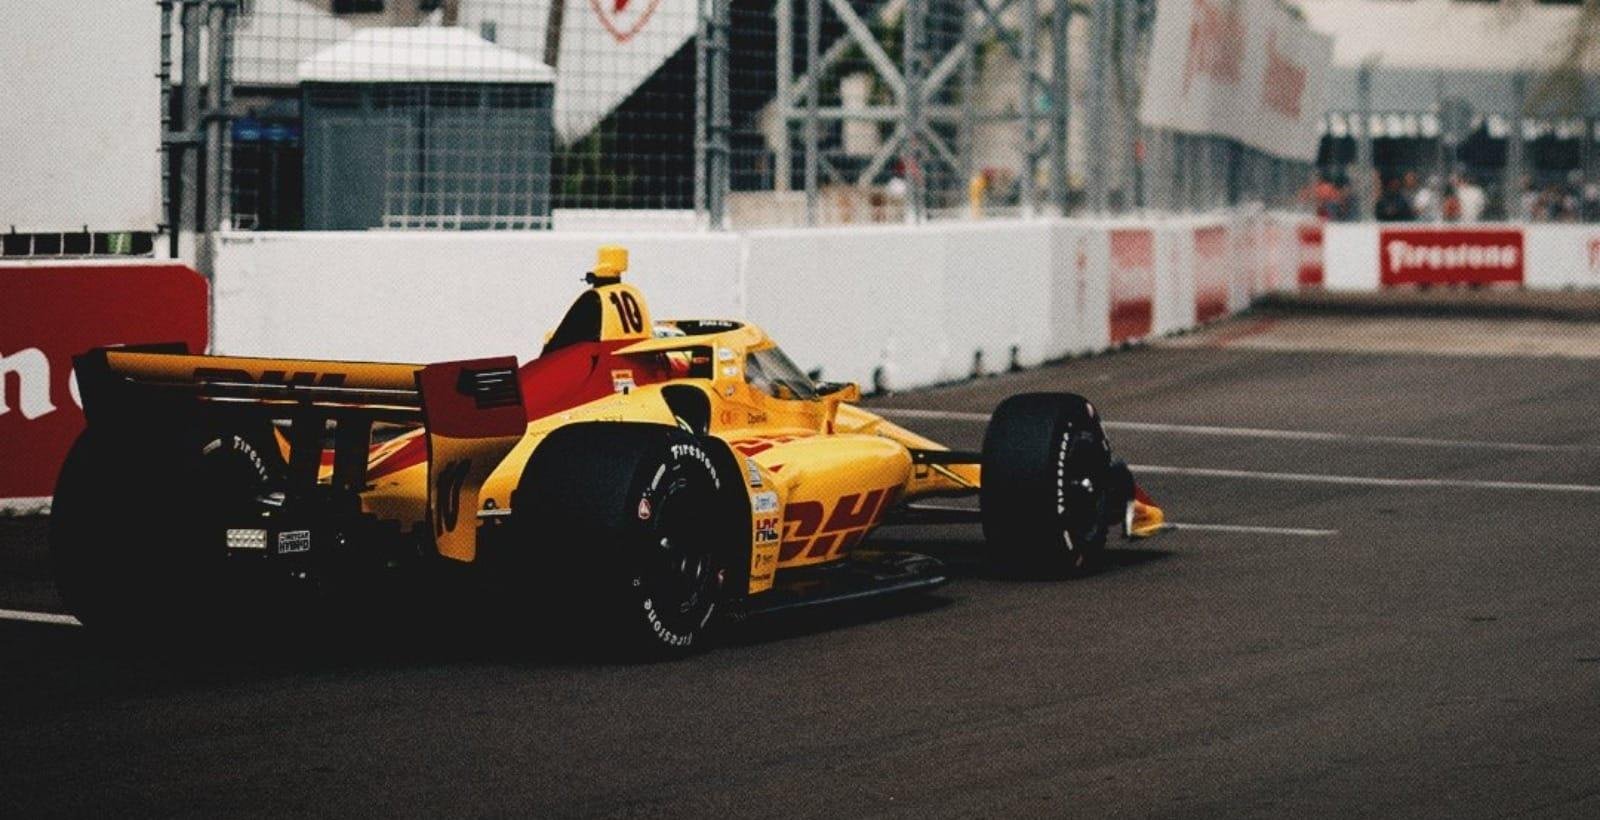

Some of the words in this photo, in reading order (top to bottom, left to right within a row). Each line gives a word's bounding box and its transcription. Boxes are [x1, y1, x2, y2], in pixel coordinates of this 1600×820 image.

[1388, 241, 1517, 273] Firestone
[608, 290, 643, 334] 10
[671, 444, 721, 489] Firestone
[643, 598, 693, 646] Firestone
